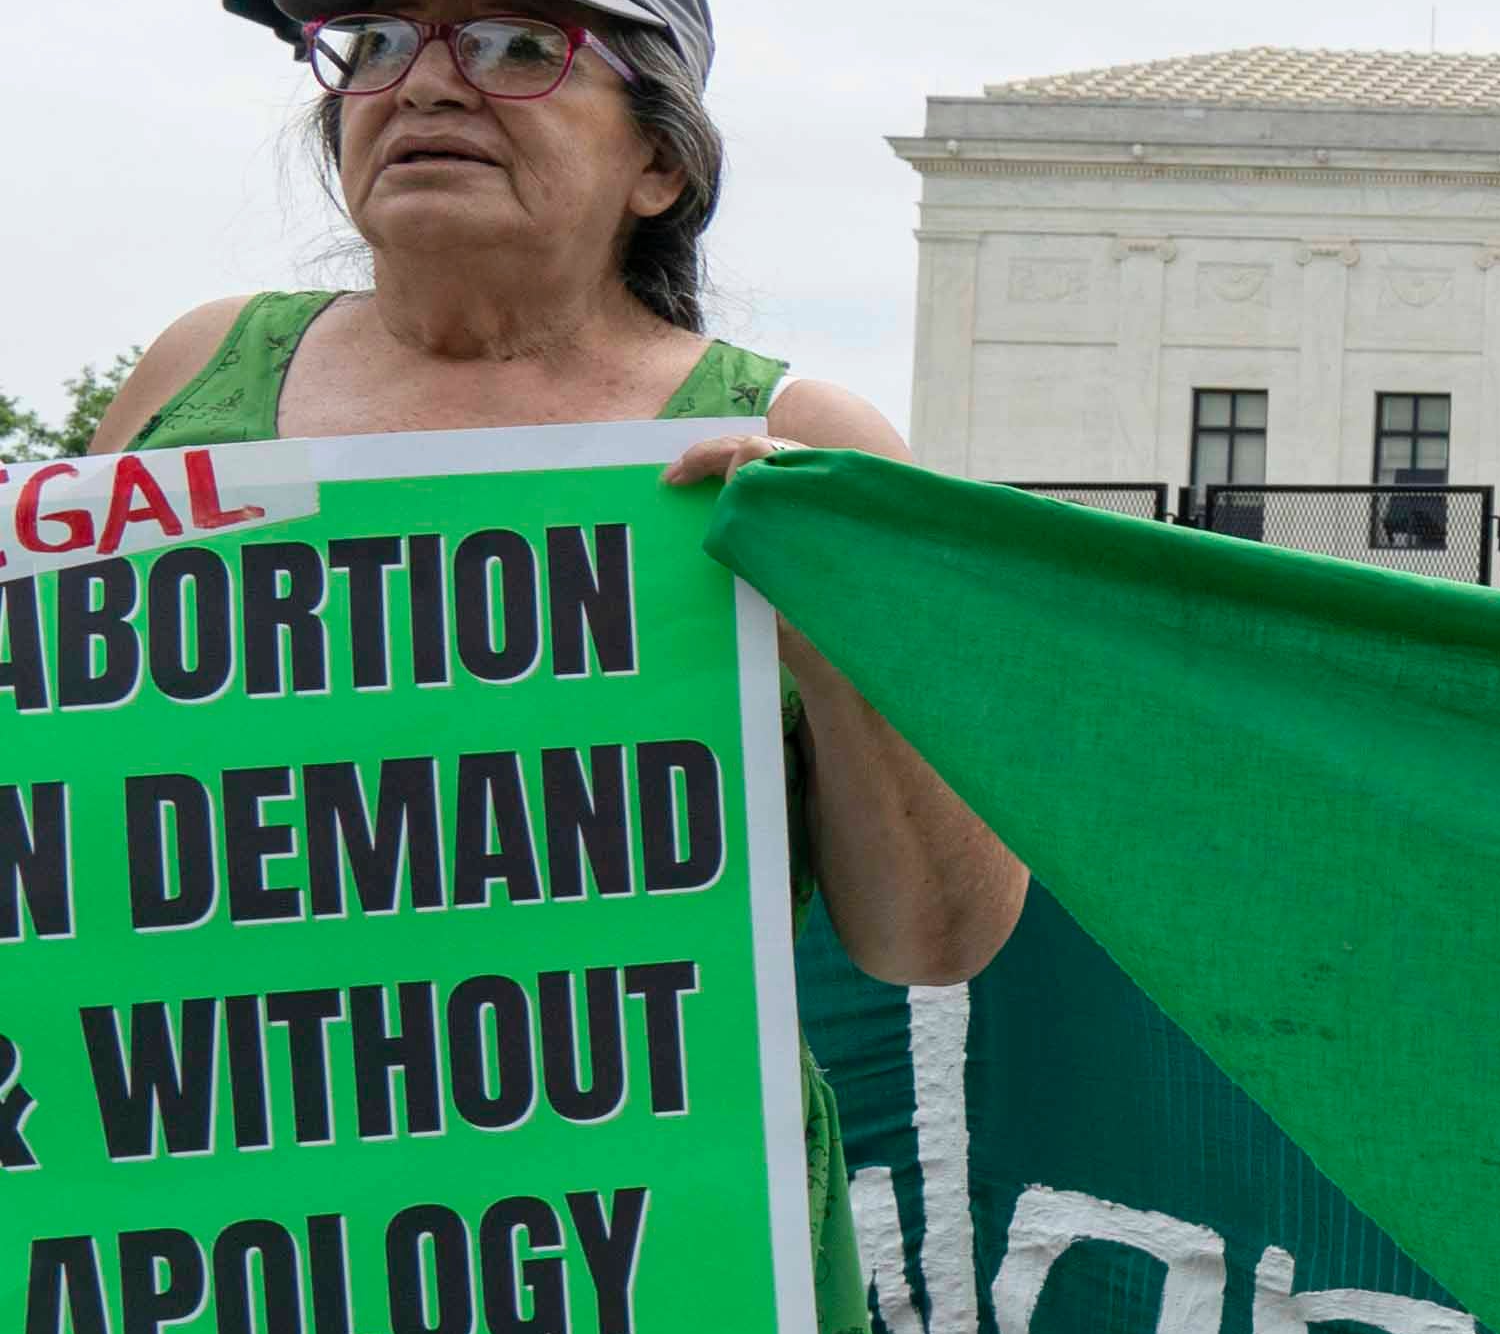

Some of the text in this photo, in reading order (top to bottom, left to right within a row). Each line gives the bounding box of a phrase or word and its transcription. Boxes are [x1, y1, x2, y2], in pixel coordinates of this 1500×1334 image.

[0, 449, 265, 566] GAL
[125, 738, 728, 935] DEMAND
[78, 960, 702, 1163] WITHOUT
